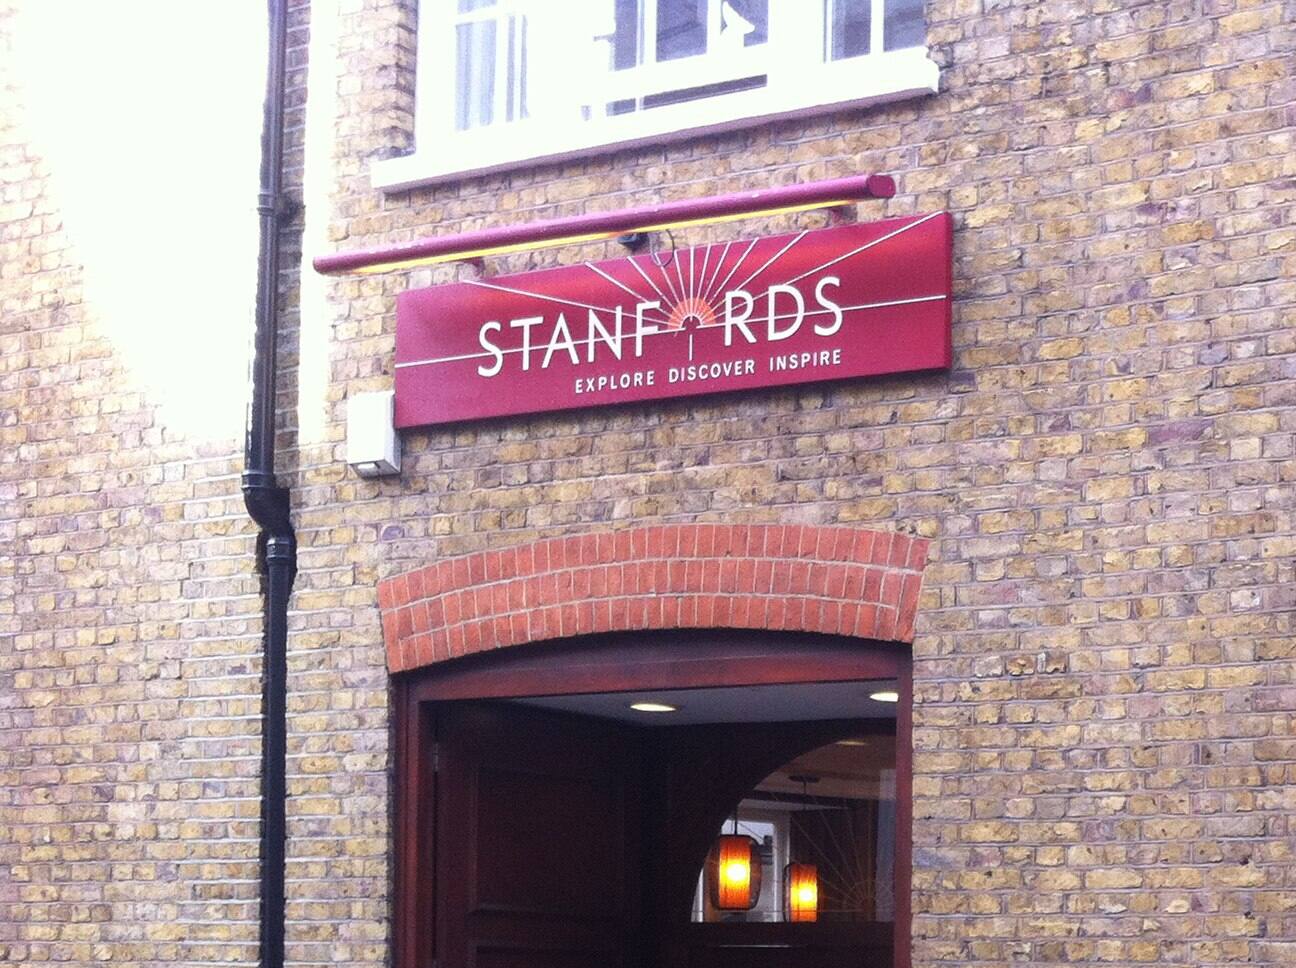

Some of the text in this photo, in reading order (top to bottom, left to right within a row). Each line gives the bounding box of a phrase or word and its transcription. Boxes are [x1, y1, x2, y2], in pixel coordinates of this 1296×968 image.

[574, 349, 842, 394] EXPLORE DISCOVER INSPIRE
